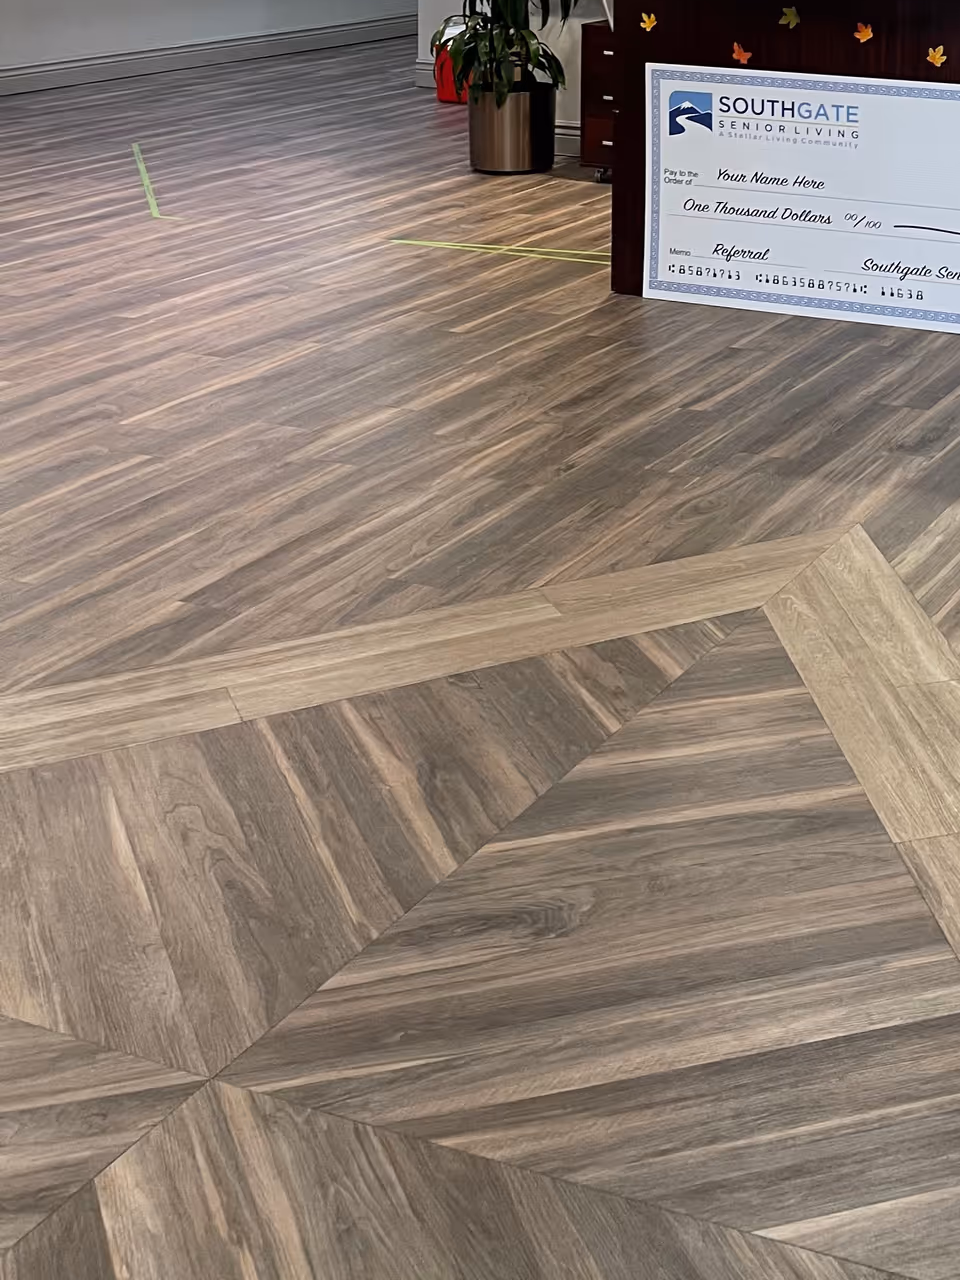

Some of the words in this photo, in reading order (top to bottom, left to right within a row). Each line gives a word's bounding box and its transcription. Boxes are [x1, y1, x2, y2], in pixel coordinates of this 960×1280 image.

[719, 96, 860, 123] SOUTHGATE
[718, 120, 786, 134] SENIOR
[794, 126, 859, 139] LIVING
[728, 131, 763, 141] Stellar
[765, 135, 798, 144] Living
[801, 138, 859, 150] Community
[664, 168, 678, 178] Pay
[678, 170, 686, 178] to
[687, 170, 699, 178] the
[664, 176, 684, 186] Order
[685, 178, 693, 186] of
[716, 168, 748, 183] Your
[750, 171, 789, 186] Name
[792, 175, 825, 190] Here
[683, 198, 710, 213] One
[714, 201, 780, 220] Thousand
[781, 207, 833, 225] Dollars
[669, 247, 691, 257] Memo
[712, 243, 770, 263] Referral
[861, 258, 933, 282] Southgate
